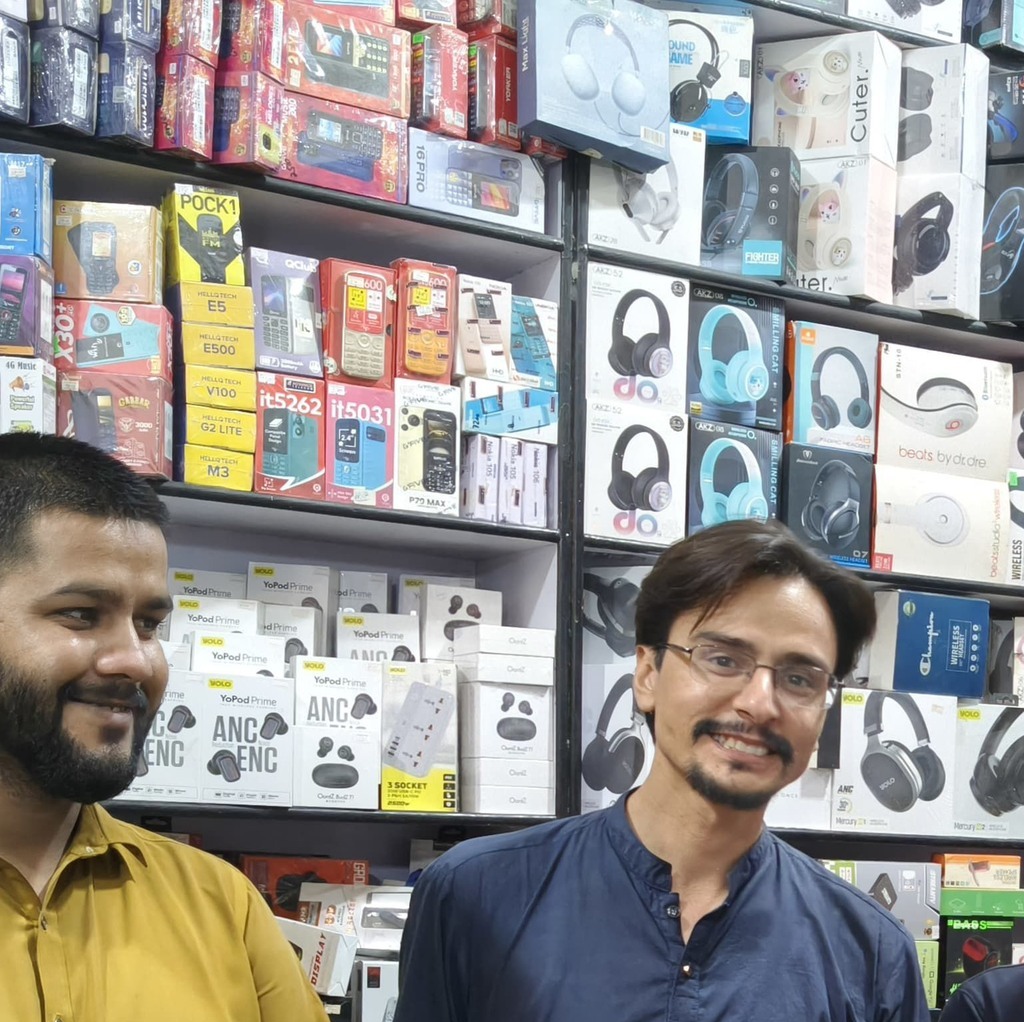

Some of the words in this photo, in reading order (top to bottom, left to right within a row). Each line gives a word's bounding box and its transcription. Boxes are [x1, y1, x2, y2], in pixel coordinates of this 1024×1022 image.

[669, 40, 696, 52] OUND
[522, 48, 530, 72] Max
[851, 69, 870, 144] Cuter.
[417, 145, 426, 162] 16
[416, 163, 426, 194] PRO
[744, 252, 780, 264] FIGHTER
[364, 280, 384, 291] 600
[208, 302, 227, 312] E5
[204, 343, 236, 356] E500
[6, 361, 16, 370] 4G
[18, 361, 38, 372] Music
[206, 386, 238, 399] V100
[260, 390, 323, 416] it5262
[331, 400, 392, 426] it5031
[200, 424, 216, 434] G2
[220, 424, 242, 437] LITE
[899, 446, 934, 462] beats
[937, 453, 952, 466] by
[208, 466, 230, 478] M3
[428, 499, 446, 508] MAX
[1012, 539, 1022, 580] WIRELESS
[184, 586, 207, 597] YoPod
[208, 588, 232, 598] Prime
[264, 581, 289, 591] YoPod
[290, 582, 314, 593] Prime
[350, 589, 372, 599] Prime
[188, 614, 214, 624] YoPod
[216, 616, 241, 626] Prime
[274, 622, 298, 632] Prime
[354, 630, 380, 640] YoPod
[380, 631, 405, 641] Prime
[951, 625, 960, 666] WIRELESS
[212, 651, 241, 662] YoPod
[242, 654, 268, 665] Prime
[314, 676, 342, 686] YoPod
[342, 678, 367, 688] Prime
[220, 694, 250, 705] YoPod
[251, 696, 278, 708] Prime
[306, 696, 348, 723] ANC
[212, 716, 258, 744] ANC
[148, 739, 184, 768] ENC
[237, 746, 278, 774] ENC
[394, 782, 428, 790] SOCKET
[838, 785, 854, 794] ANC
[836, 818, 858, 826] Mercury
[954, 822, 976, 832] Mercury
[310, 932, 327, 986] DISPLAY
